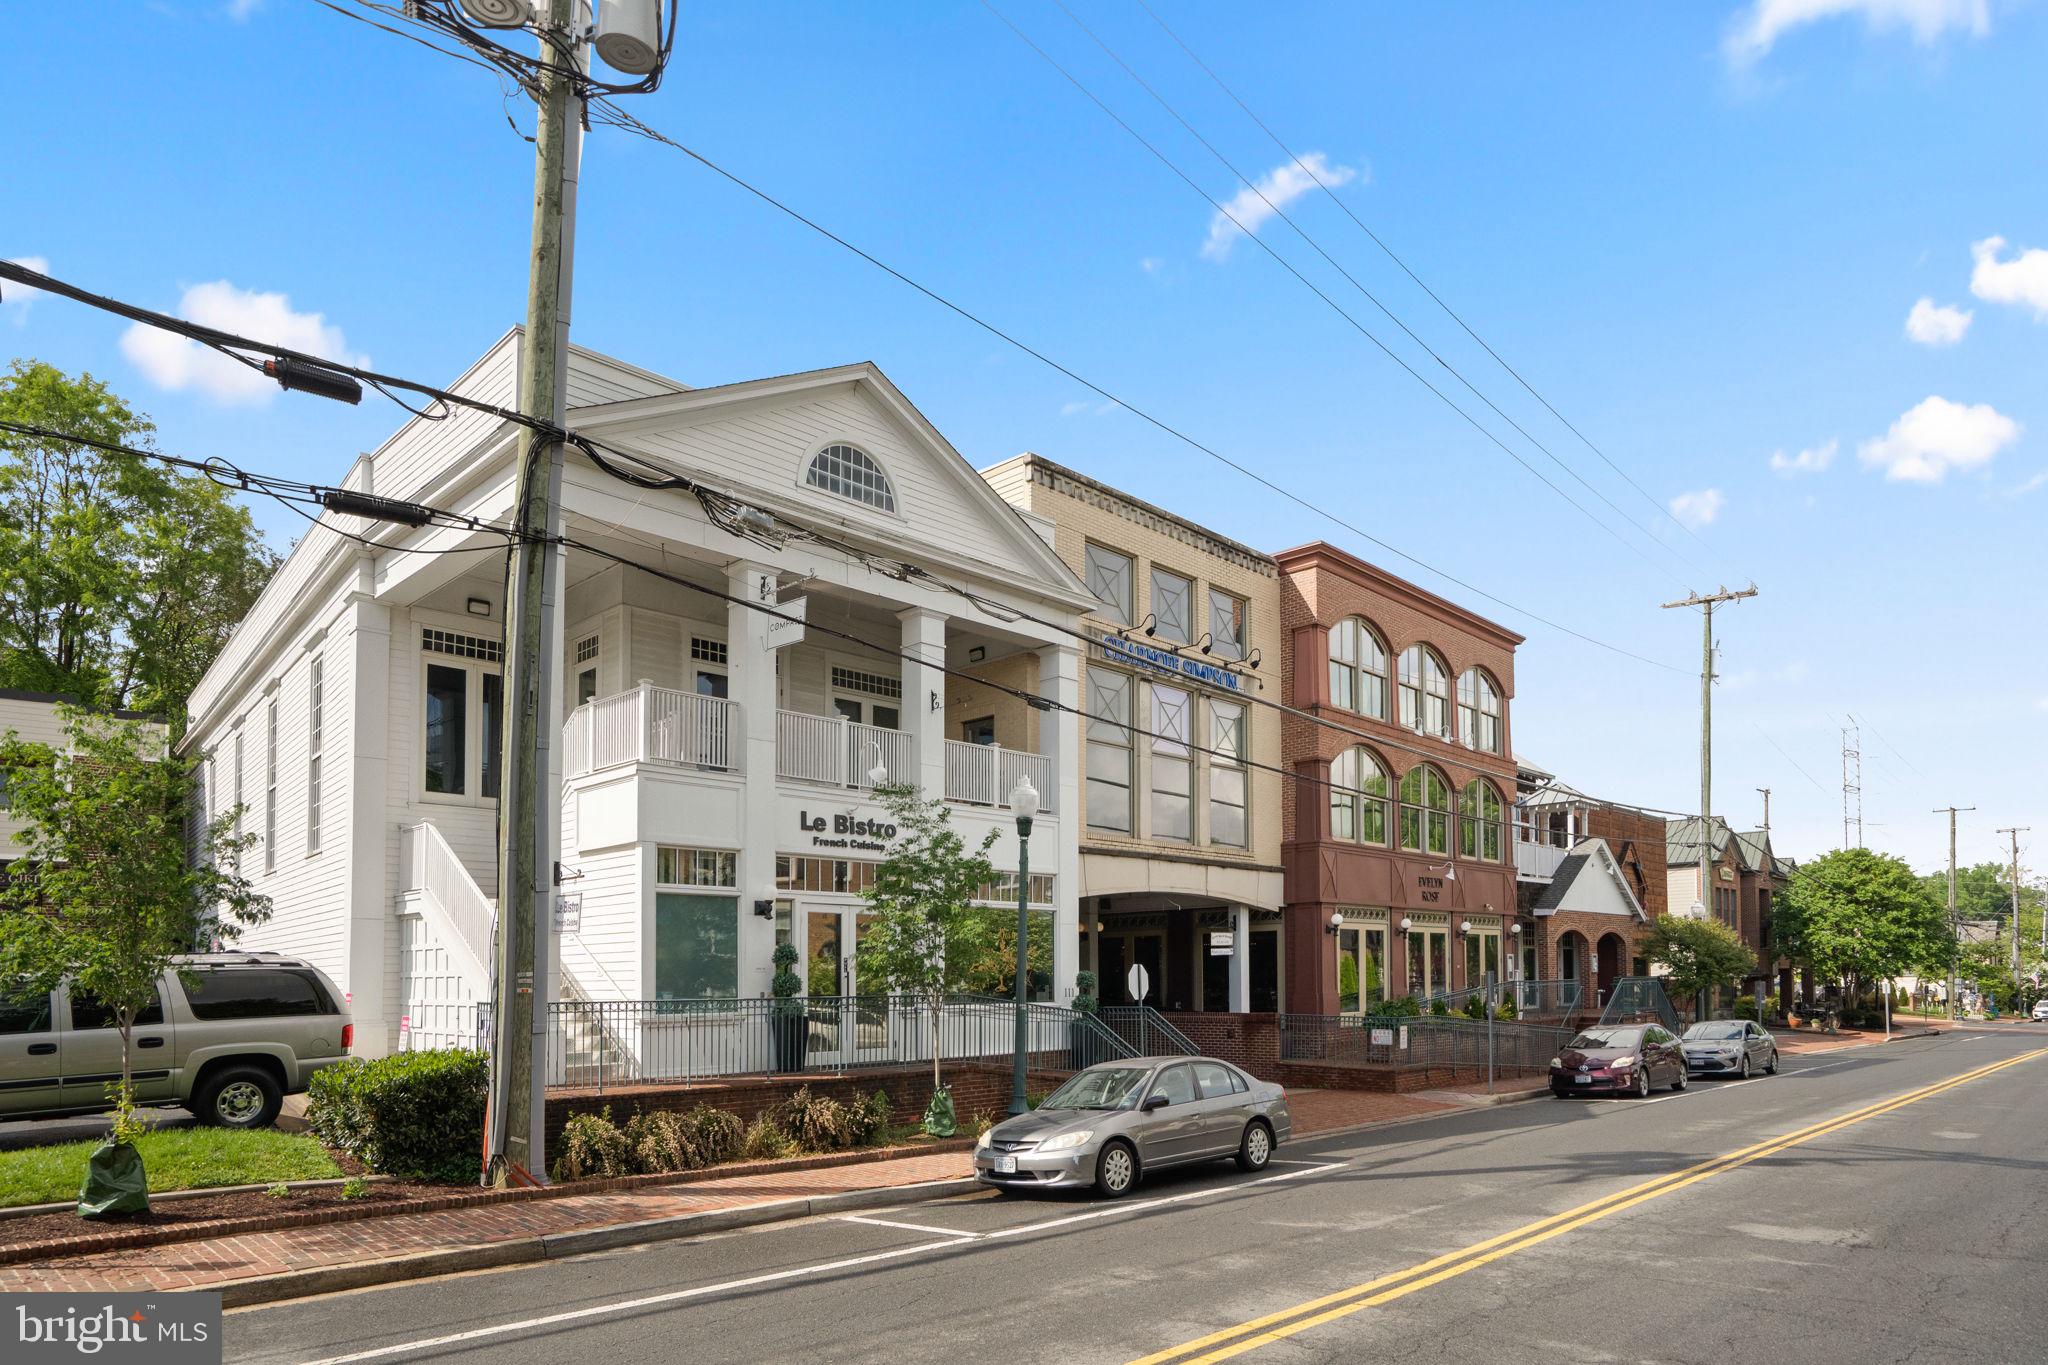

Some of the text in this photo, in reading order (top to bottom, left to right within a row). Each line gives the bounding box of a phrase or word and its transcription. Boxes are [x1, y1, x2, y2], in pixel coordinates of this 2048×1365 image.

[800, 810, 897, 838] Le Bistro
[813, 836, 886, 851] French Cuisine
[1418, 876, 1444, 889] EVELYN
[1421, 891, 1440, 902] ROSE
[563, 900, 579, 913] Bistro
